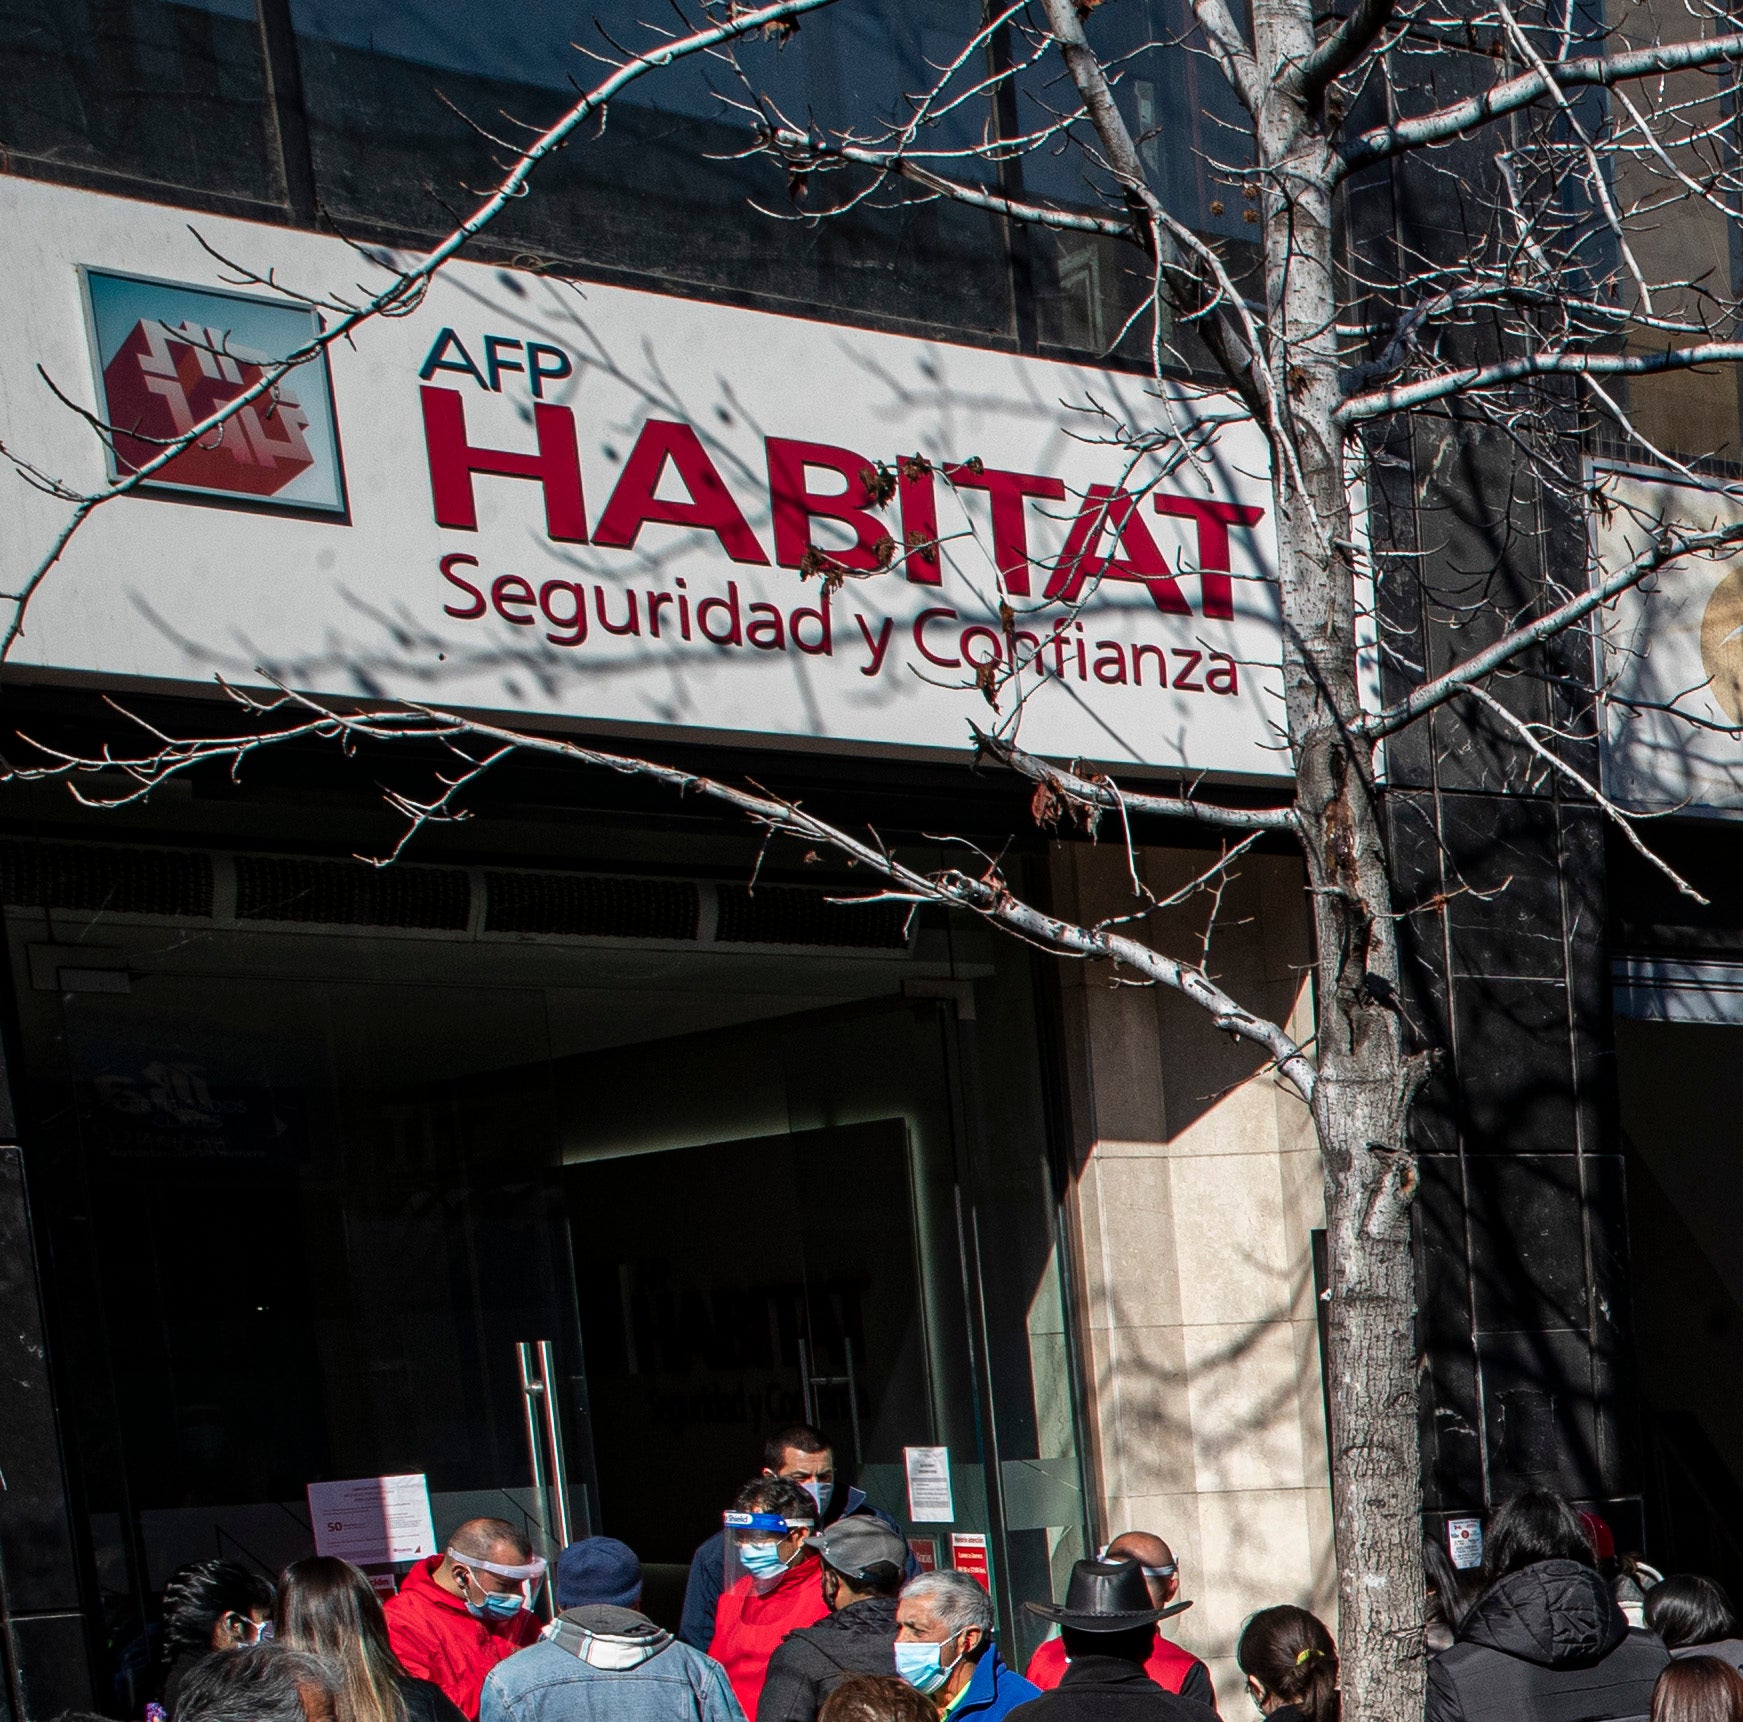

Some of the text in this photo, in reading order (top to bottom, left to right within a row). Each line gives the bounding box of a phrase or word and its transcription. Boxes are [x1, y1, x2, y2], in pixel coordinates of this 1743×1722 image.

[419, 326, 573, 400] AFP
[421, 384, 1265, 622] HABITAT
[440, 553, 1241, 698] Seguridad y Confianza
[327, 1521, 343, 1533] 50
